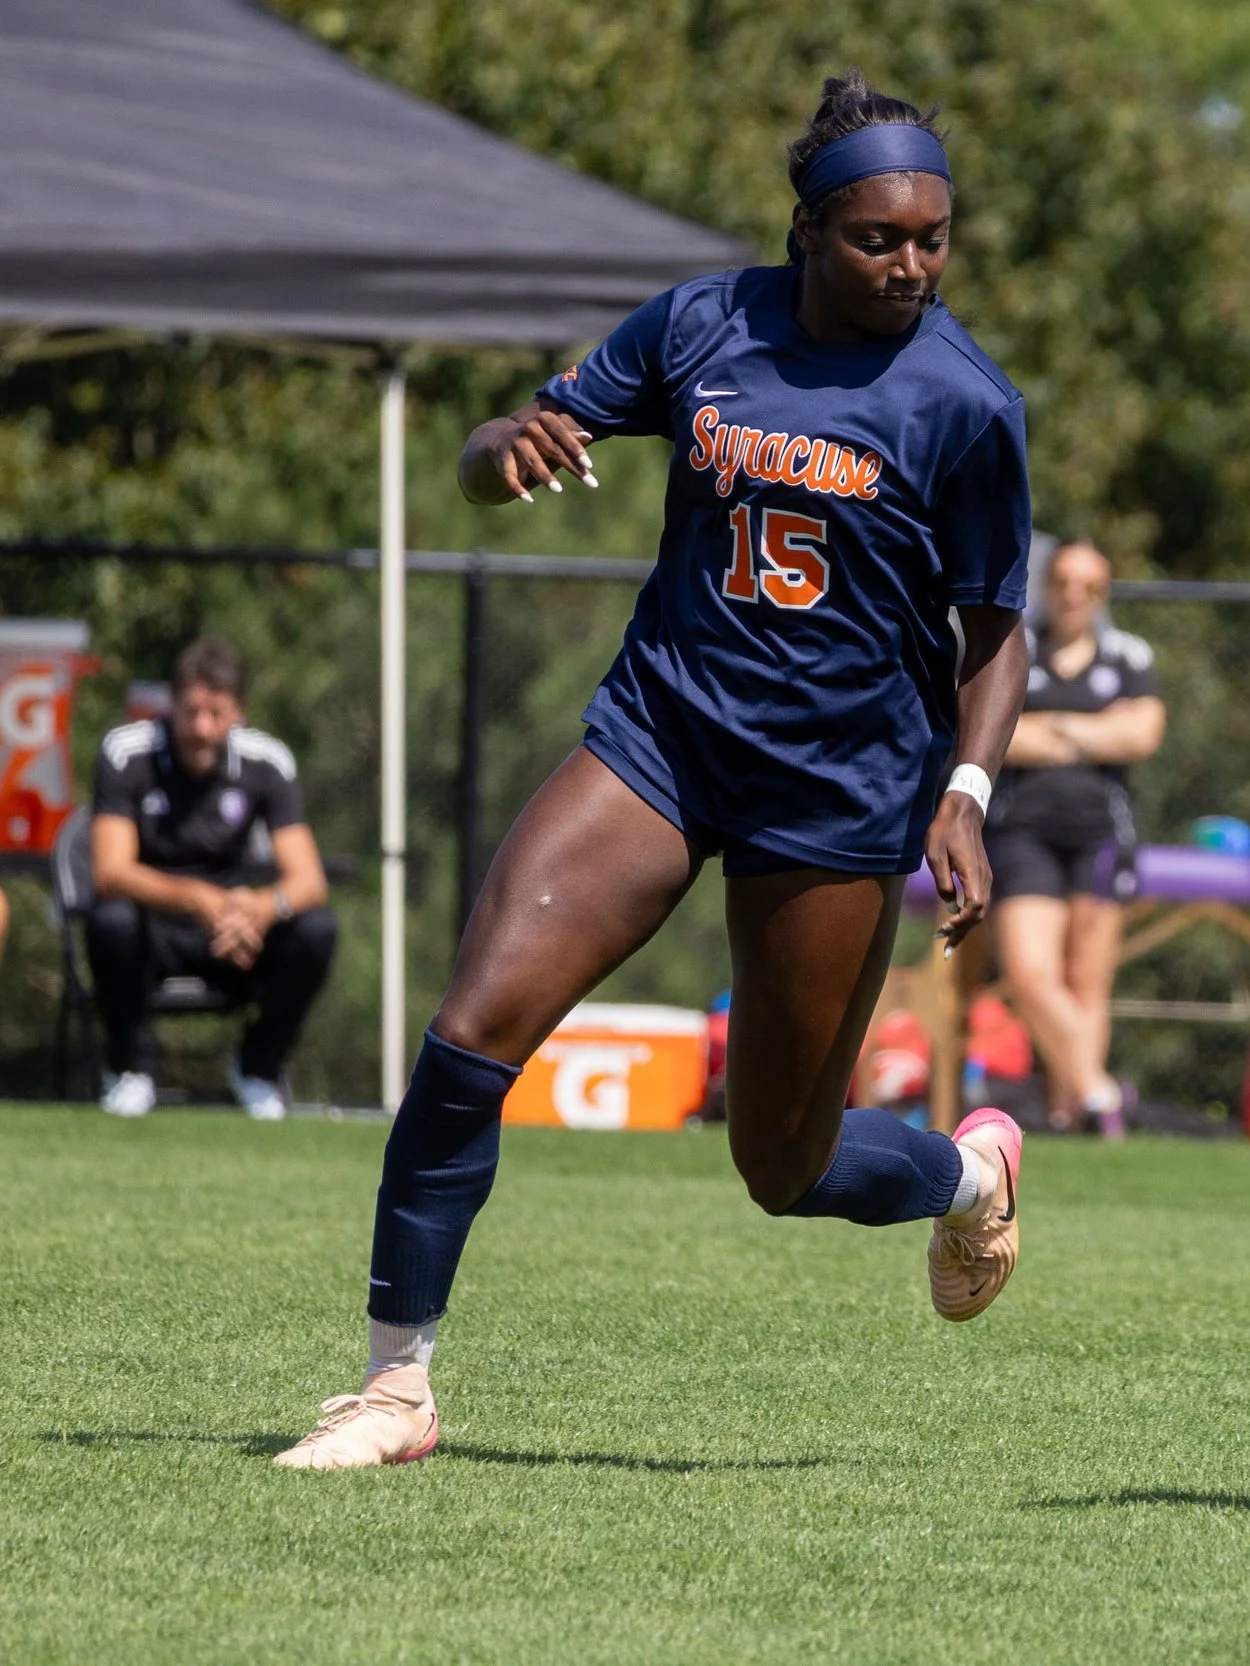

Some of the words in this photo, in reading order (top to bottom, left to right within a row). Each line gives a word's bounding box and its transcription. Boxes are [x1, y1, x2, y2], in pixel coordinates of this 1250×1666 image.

[689, 405, 882, 500] Syracuse
[722, 502, 830, 610] 15
[0, 675, 56, 742] G
[552, 1048, 631, 1131] G
